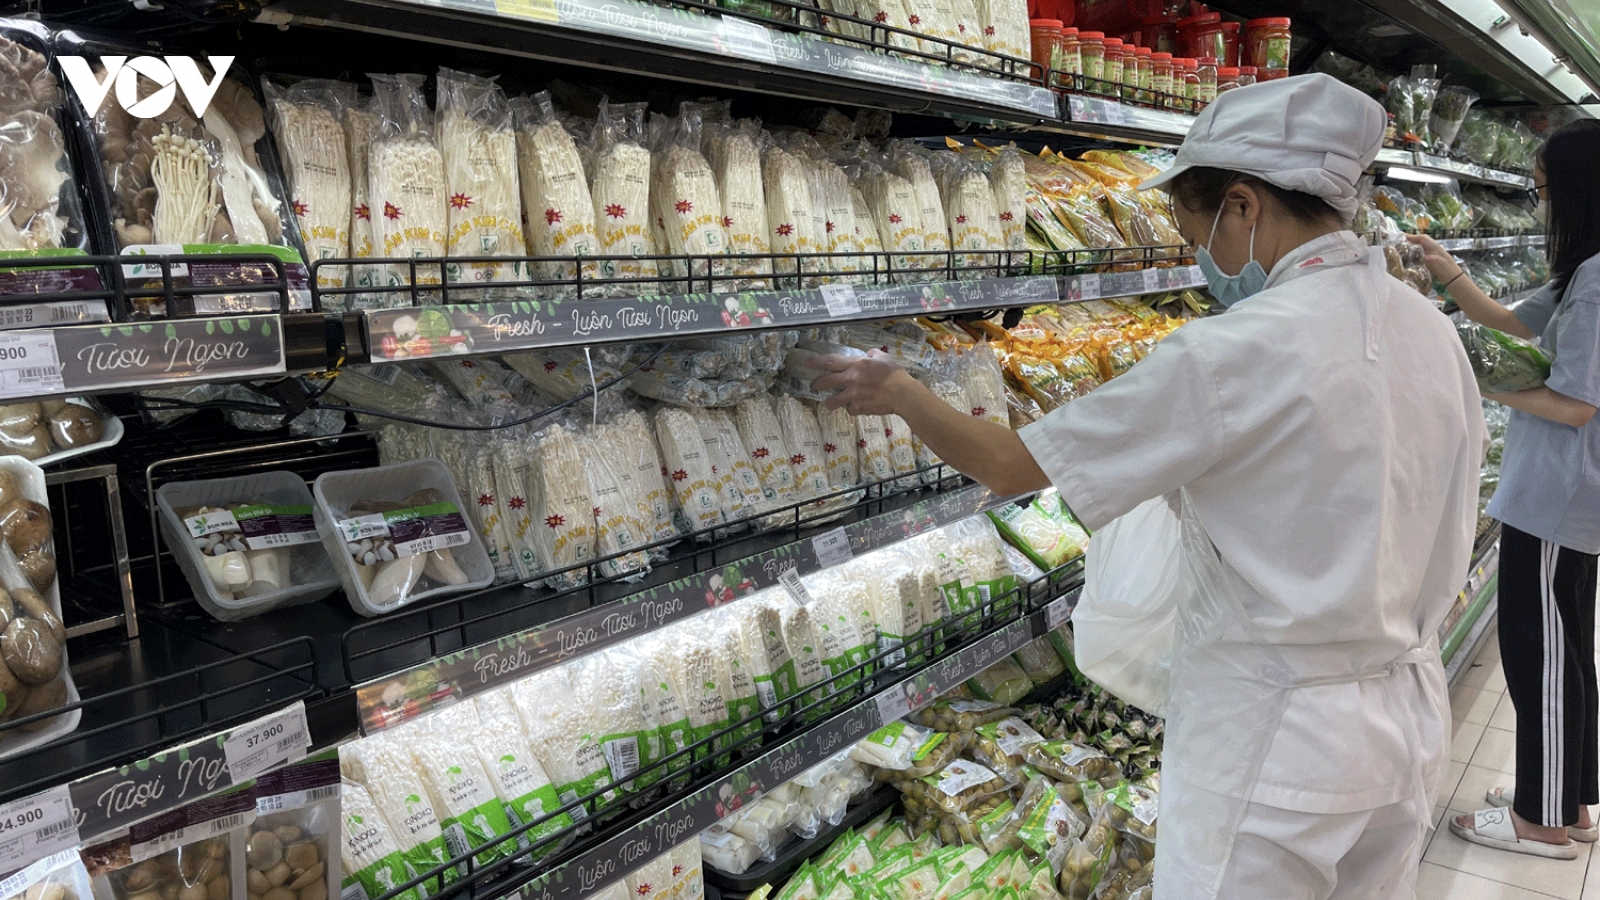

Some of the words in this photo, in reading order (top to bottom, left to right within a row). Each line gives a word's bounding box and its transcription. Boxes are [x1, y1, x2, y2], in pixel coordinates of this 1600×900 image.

[404, 227, 430, 241] KIM
[472, 215, 497, 229] KIM
[488, 313, 545, 341] Fresh
[572, 309, 612, 336] Luôn
[616, 306, 652, 329] Tươi
[655, 304, 699, 331] Ngon
[77, 343, 150, 373] Tươi
[164, 337, 249, 373] Ngon
[474, 646, 531, 683] Fresh
[557, 626, 597, 657] Luôn
[601, 611, 637, 637] Tươi
[641, 597, 683, 628] Ngon
[246, 723, 284, 748] 37.900
[770, 750, 803, 780] Fresh
[817, 732, 842, 756] Luôn
[404, 807, 432, 826] KINOKO
[348, 827, 377, 847] KINOKO
[578, 858, 615, 895] Luôn
[619, 836, 651, 866] Tươi
[655, 814, 694, 851] Ngon
